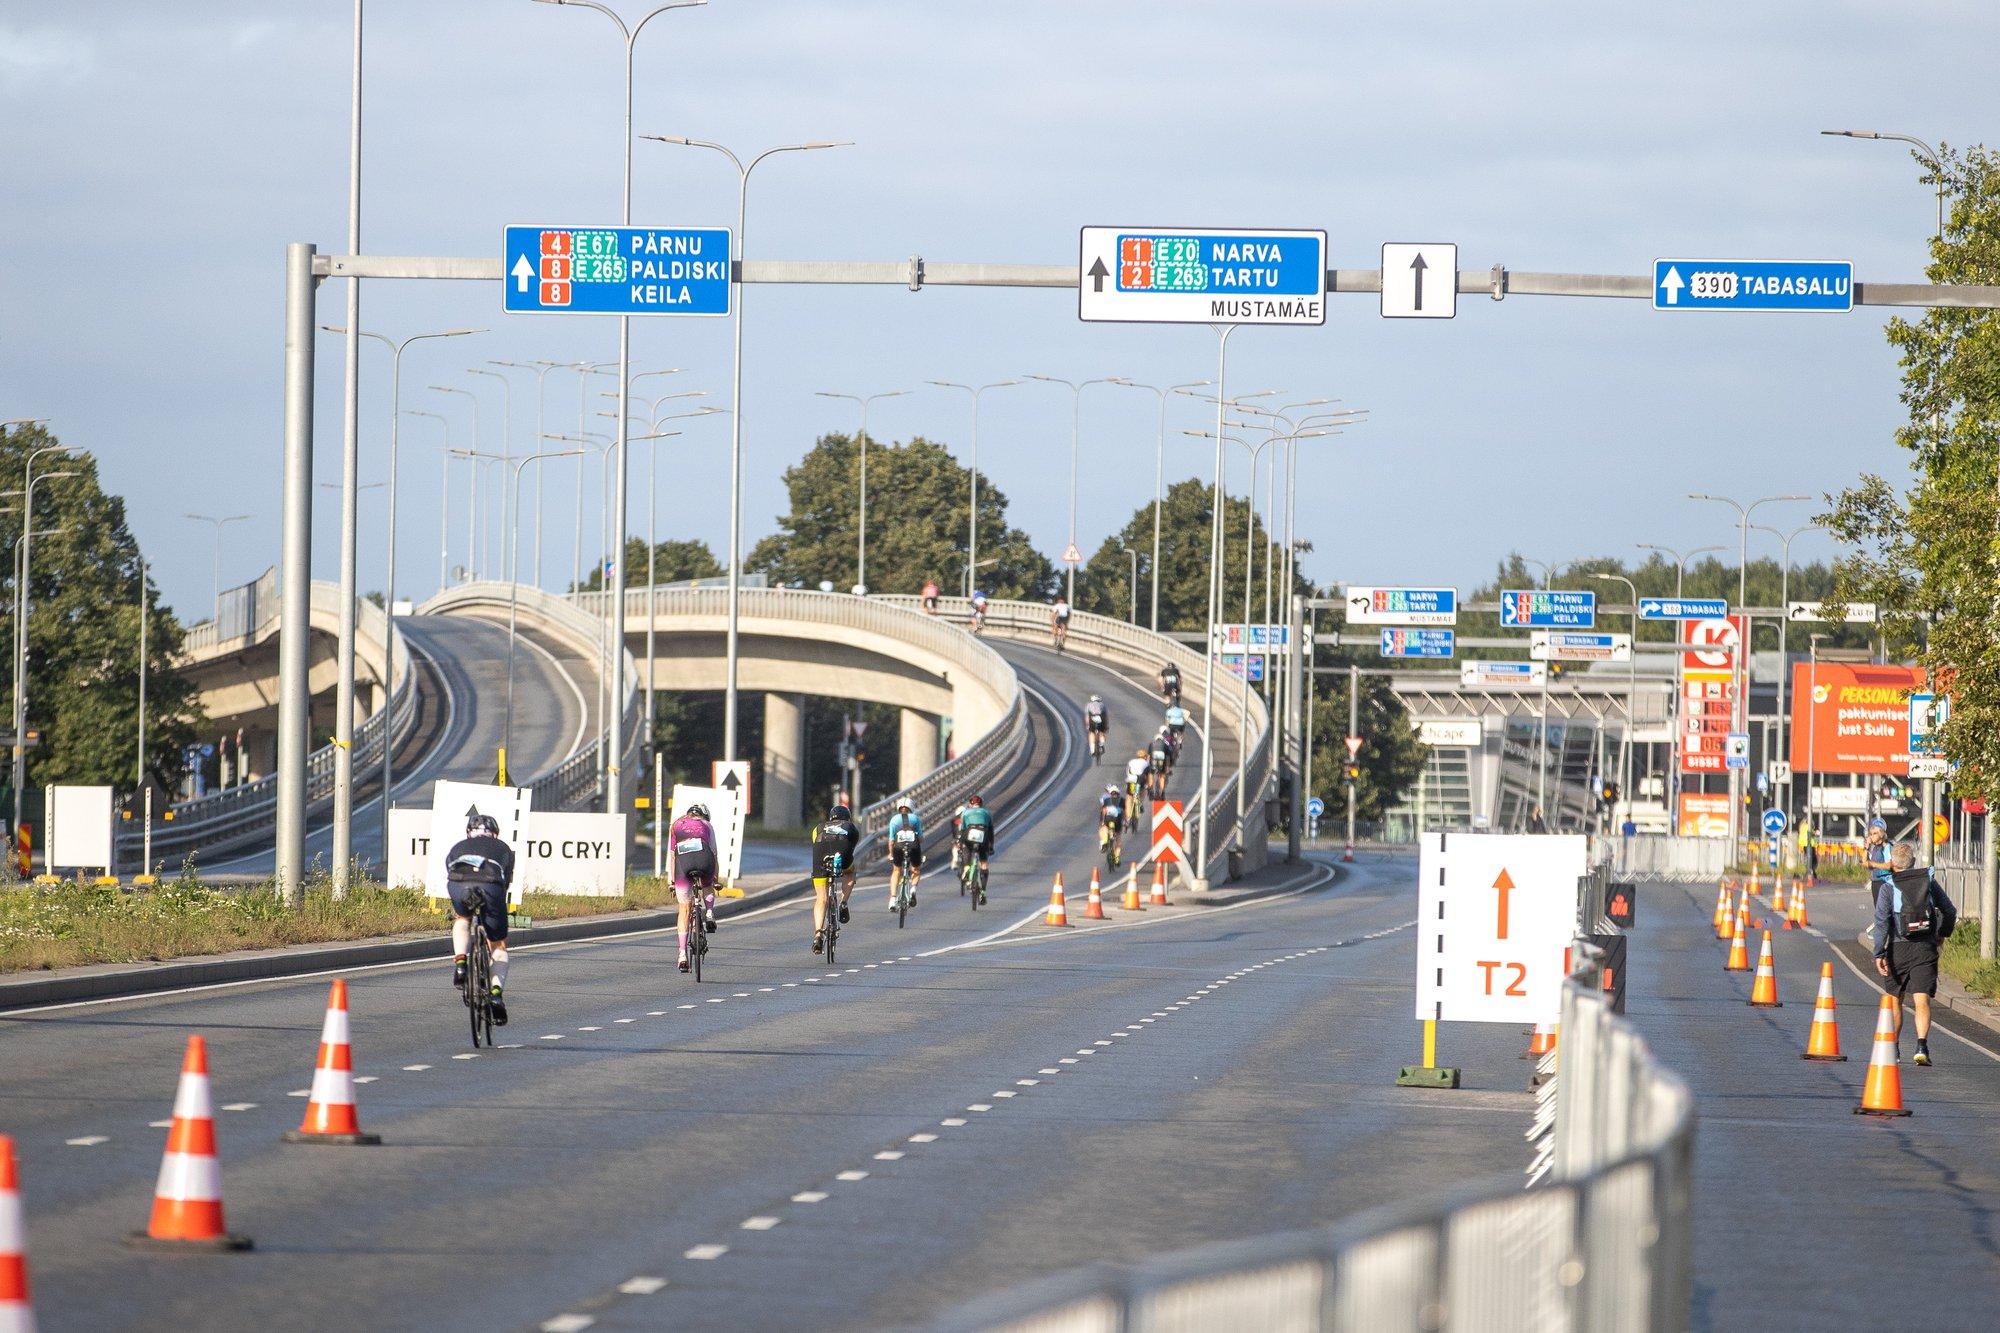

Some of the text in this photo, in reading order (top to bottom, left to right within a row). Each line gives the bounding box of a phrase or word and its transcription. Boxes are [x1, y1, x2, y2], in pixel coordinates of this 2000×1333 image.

[551, 235, 562, 252] 4
[631, 232, 702, 254] PÄRNU
[1132, 243, 1141, 260] 1
[1212, 244, 1282, 262] NARVA
[551, 260, 562, 278] 8
[631, 260, 726, 280] PALDISKI
[1131, 268, 1142, 286] 2
[1212, 268, 1278, 288] TARTU
[550, 284, 692, 304] 8 KEILA
[1697, 276, 1848, 296] 390 TABASALU
[1211, 297, 1320, 318] MUSTAMÄE
[1409, 592, 1438, 602] NARVA
[1410, 602, 1437, 611] TARTU
[1553, 614, 1579, 623] KEILA
[1554, 604, 1592, 614] PALDISKI
[1681, 604, 1724, 614] TABASALU
[1838, 722, 1896, 737] just Sulle
[412, 838, 612, 860] IT TO CRY!
[1476, 960, 1528, 996] T2
